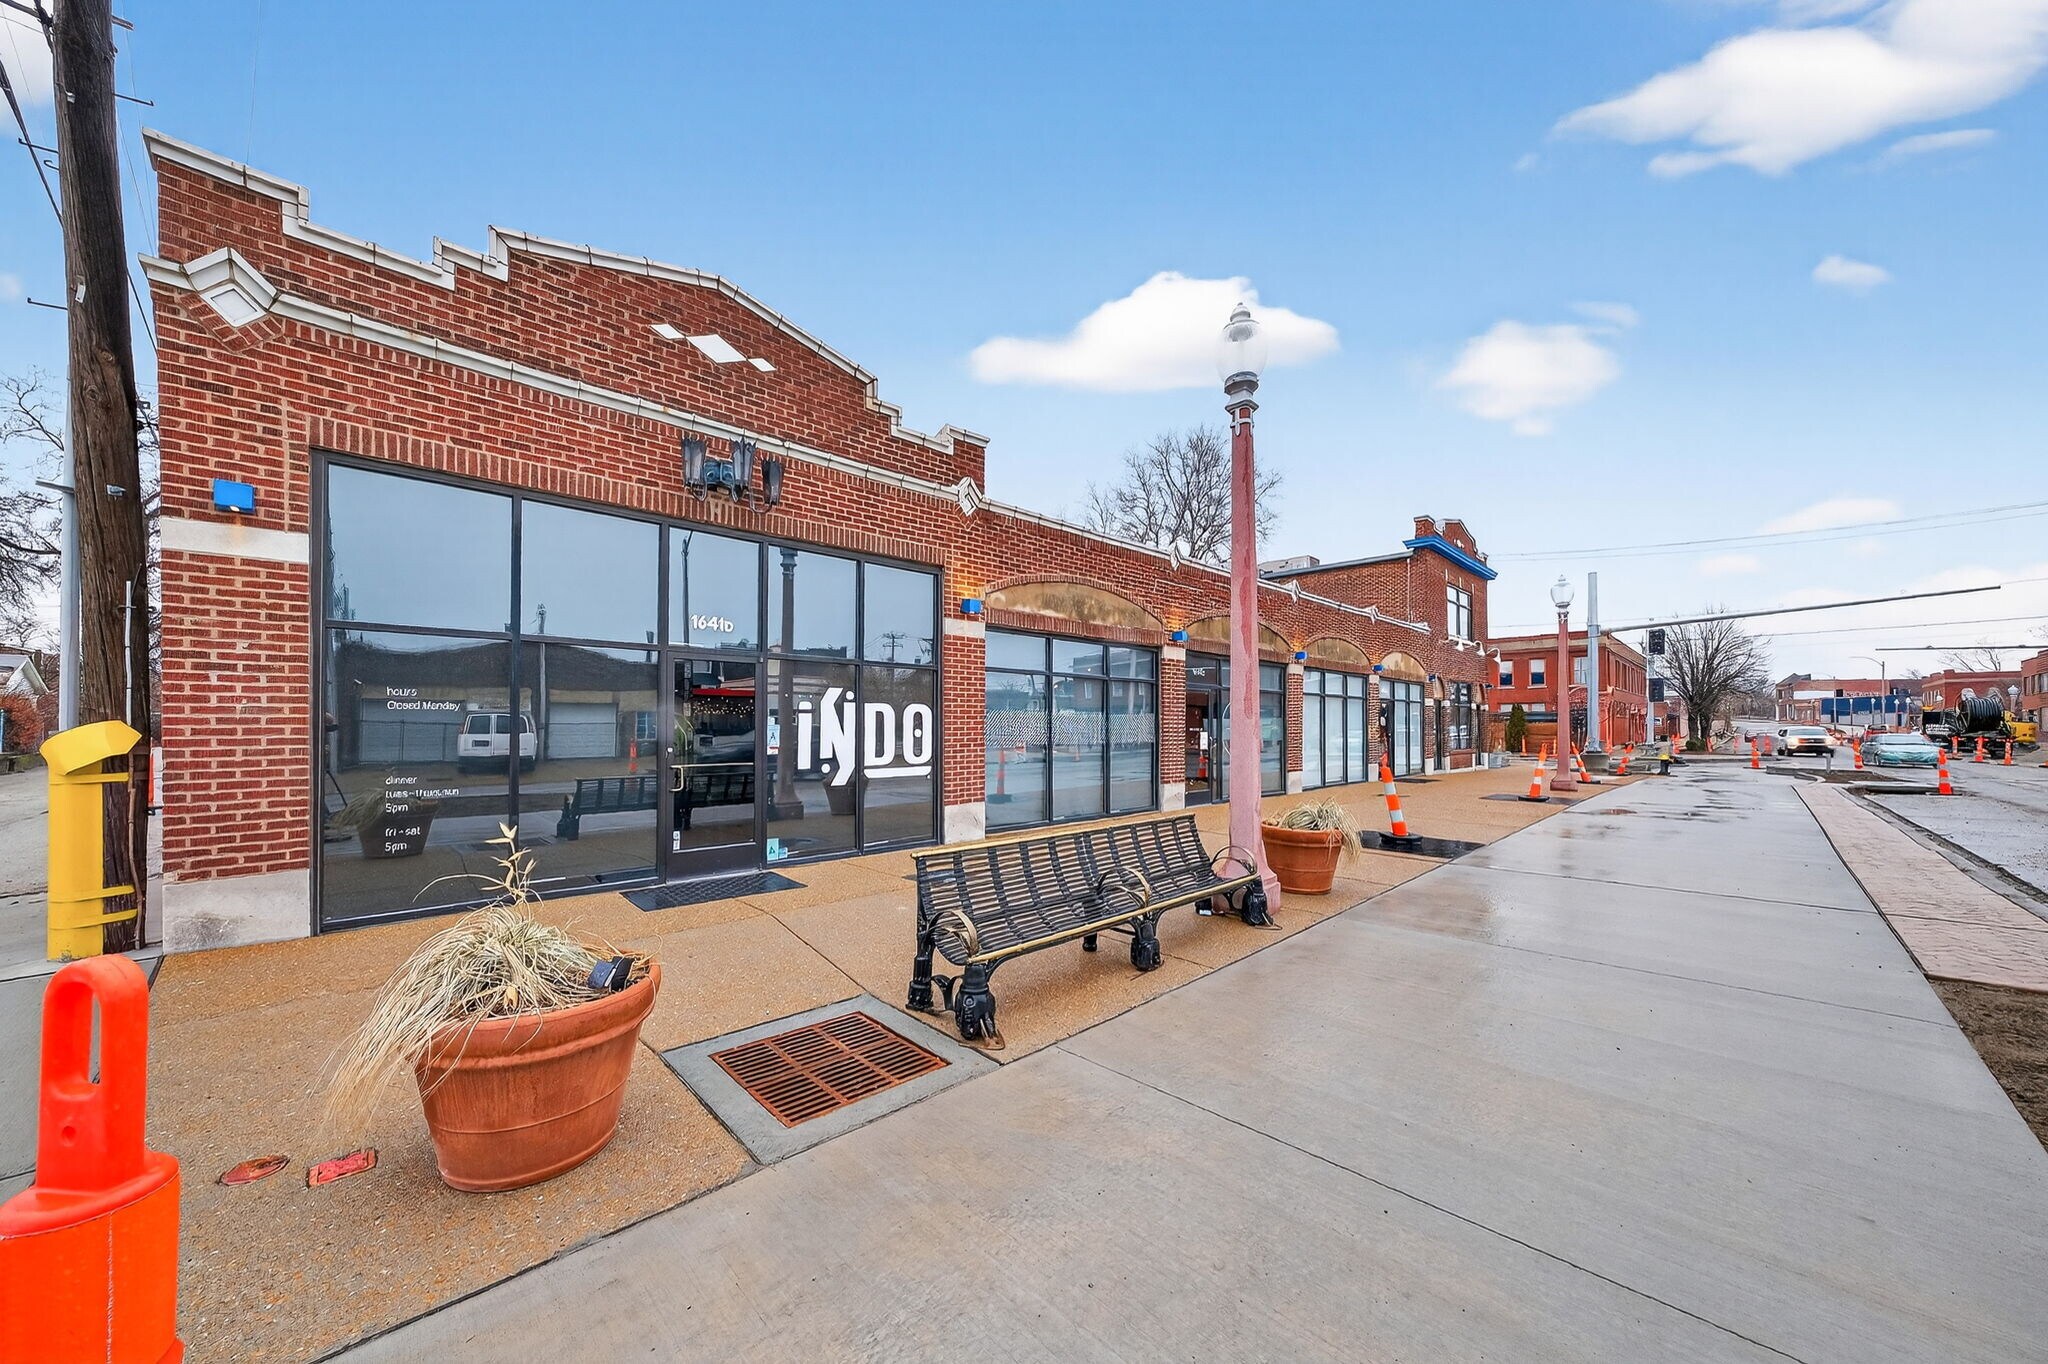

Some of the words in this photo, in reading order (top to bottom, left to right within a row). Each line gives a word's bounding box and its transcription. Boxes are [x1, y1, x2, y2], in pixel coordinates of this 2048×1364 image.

[690, 614, 734, 632] 1641D
[386, 686, 417, 696] hours
[422, 700, 461, 712] Monday
[385, 776, 418, 785] dinner
[385, 802, 409, 814] 5pm
[405, 826, 421, 836] sat
[385, 841, 407, 854] 5pm
